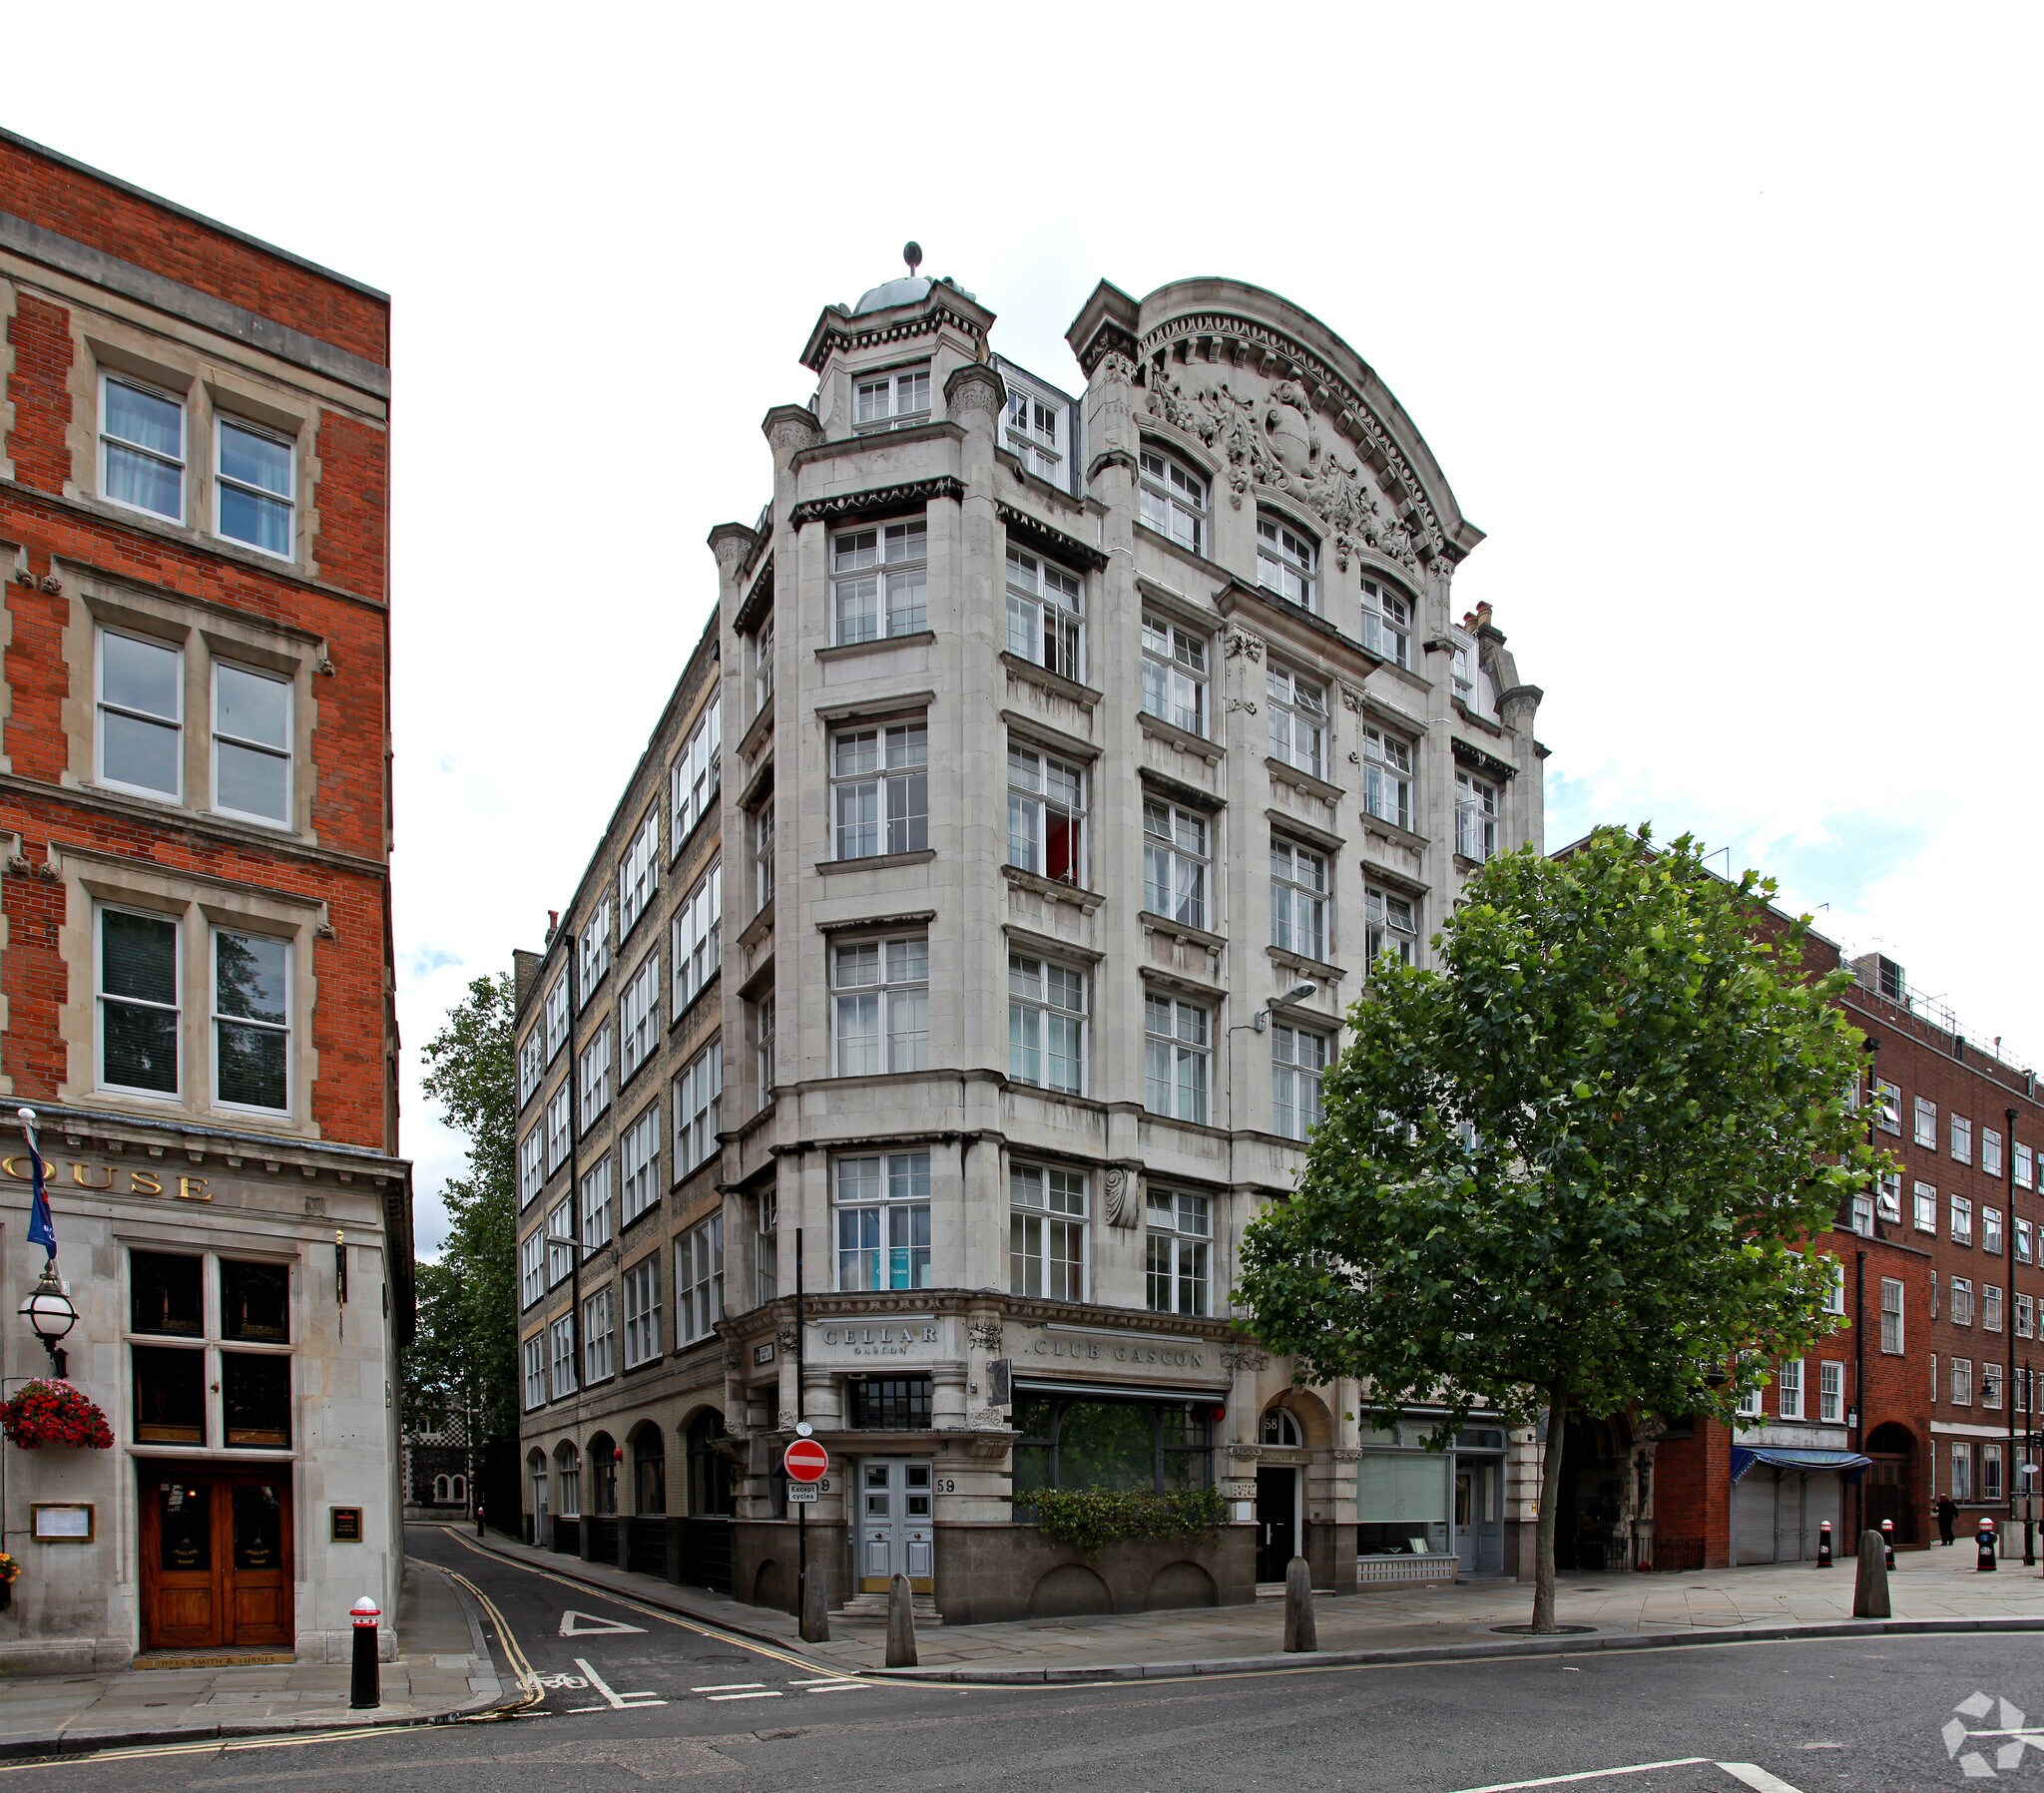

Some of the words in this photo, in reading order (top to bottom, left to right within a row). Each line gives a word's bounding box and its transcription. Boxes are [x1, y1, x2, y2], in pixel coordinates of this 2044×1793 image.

[824, 1327, 937, 1345] CELLAR
[1034, 1340, 1100, 1360] CLUB
[1114, 1348, 1204, 1367] GASCON
[1265, 1418, 1278, 1430] 58
[937, 1480, 955, 1493] 59
